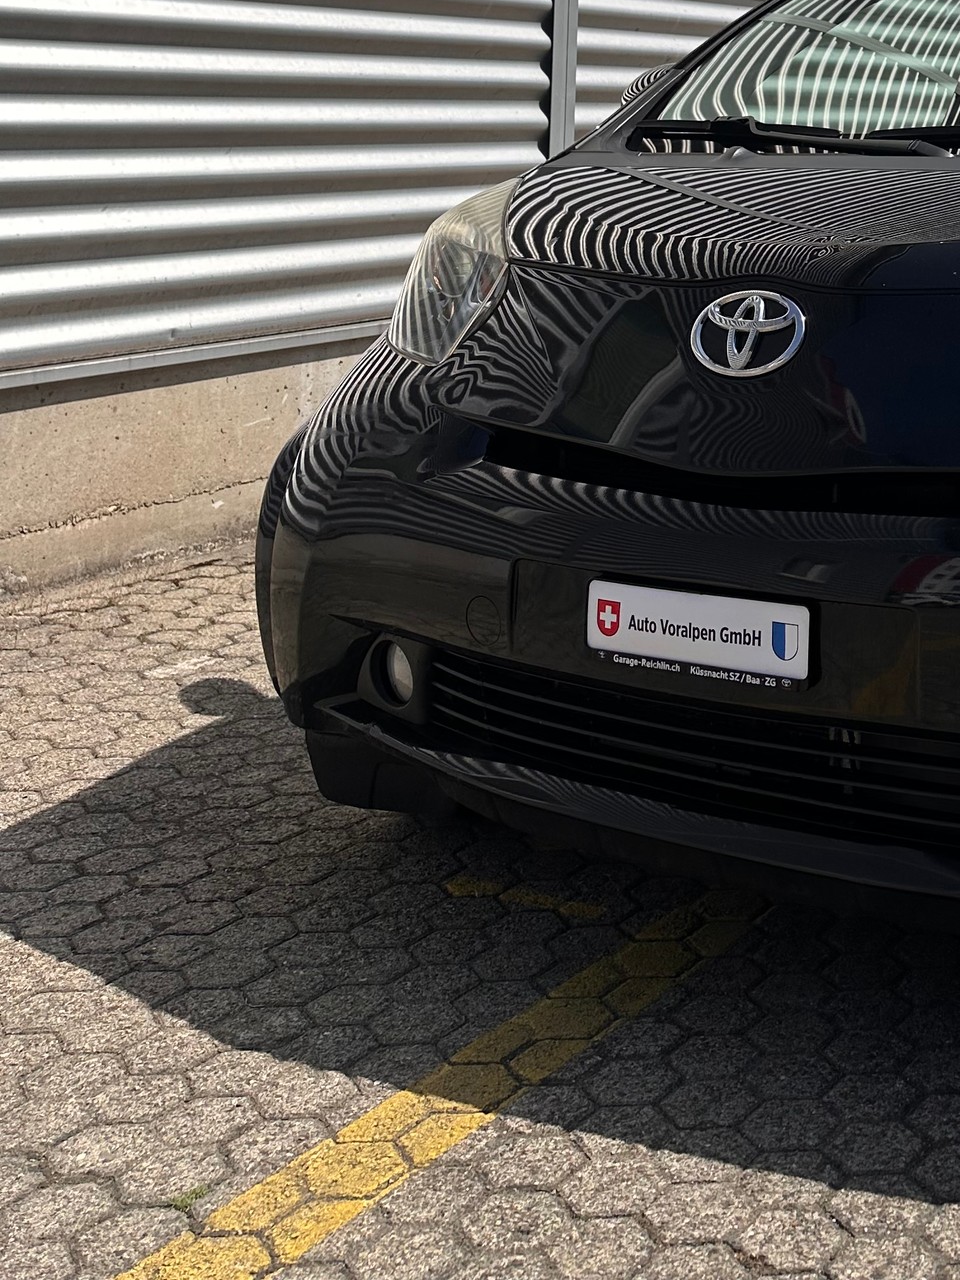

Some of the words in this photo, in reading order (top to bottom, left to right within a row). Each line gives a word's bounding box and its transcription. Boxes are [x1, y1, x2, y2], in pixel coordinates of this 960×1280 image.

[628, 614, 657, 634] Auto
[660, 618, 716, 642] Voralpen
[720, 627, 761, 647] GmbH
[613, 654, 680, 672] Garage-Reichlin.ch
[690, 665, 728, 681] Küssnacht
[729, 672, 740, 682] SZ
[764, 677, 776, 687] ZG
